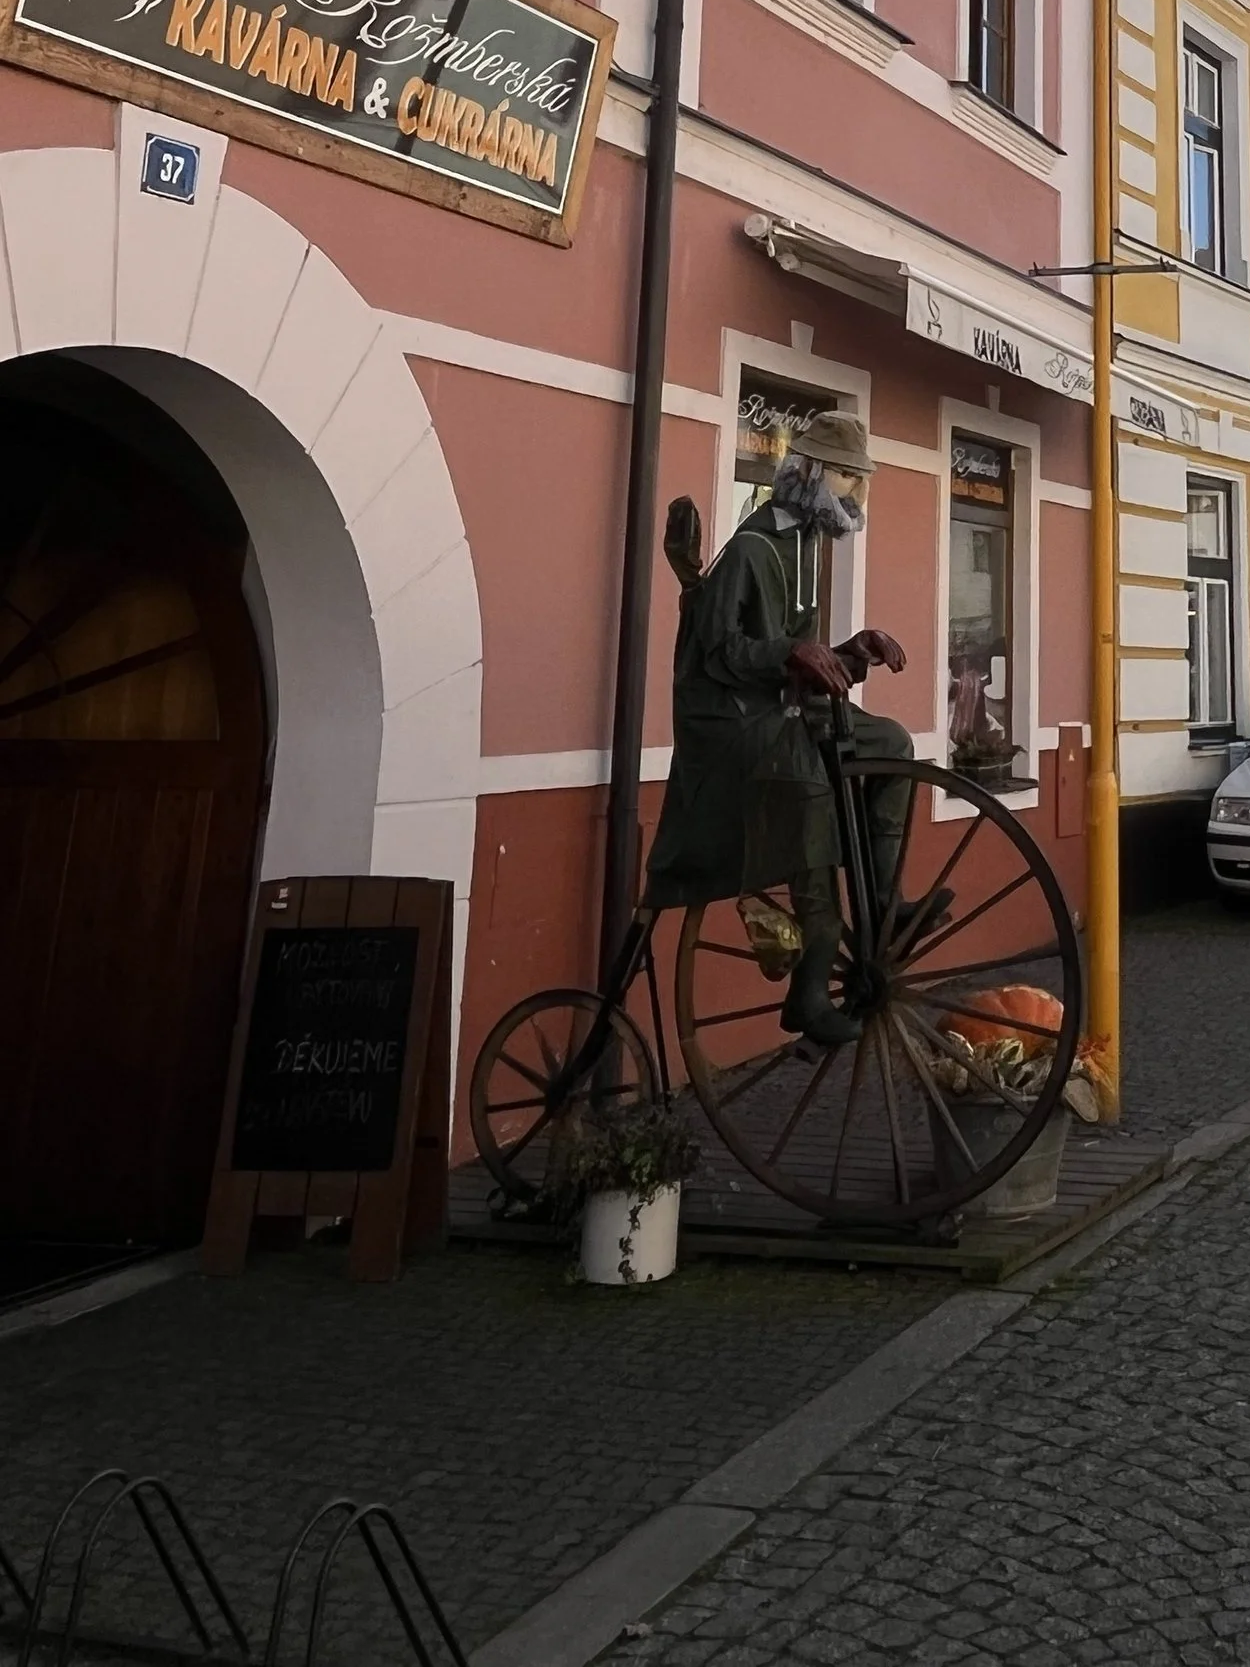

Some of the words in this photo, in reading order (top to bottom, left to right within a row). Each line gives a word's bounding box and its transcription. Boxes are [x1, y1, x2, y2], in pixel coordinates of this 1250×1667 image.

[363, 77, 390, 119] &
[397, 76, 558, 186] CUKRÁRNA
[160, 153, 185, 184] 37
